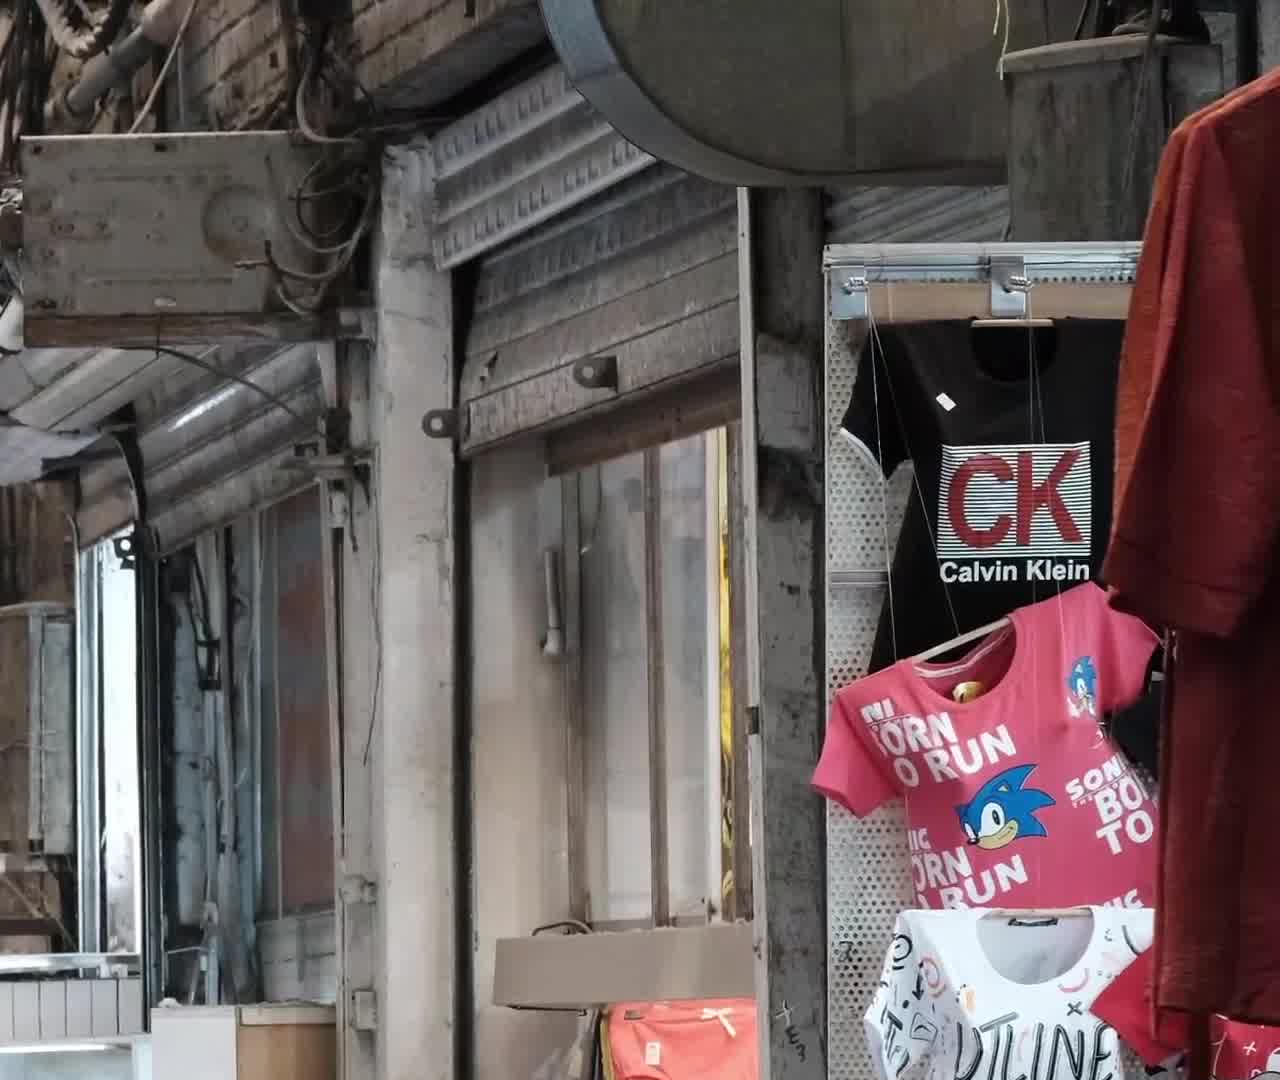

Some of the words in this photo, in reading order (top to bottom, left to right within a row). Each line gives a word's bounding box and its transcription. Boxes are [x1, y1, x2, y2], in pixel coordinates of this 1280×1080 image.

[947, 450, 1084, 549] CK
[940, 561, 1017, 583] Calvin
[1026, 560, 1090, 582] Klein
[870, 712, 958, 757] ORN
[924, 724, 1016, 783] RUN
[1094, 770, 1149, 824] BO
[1096, 810, 1153, 855] TO
